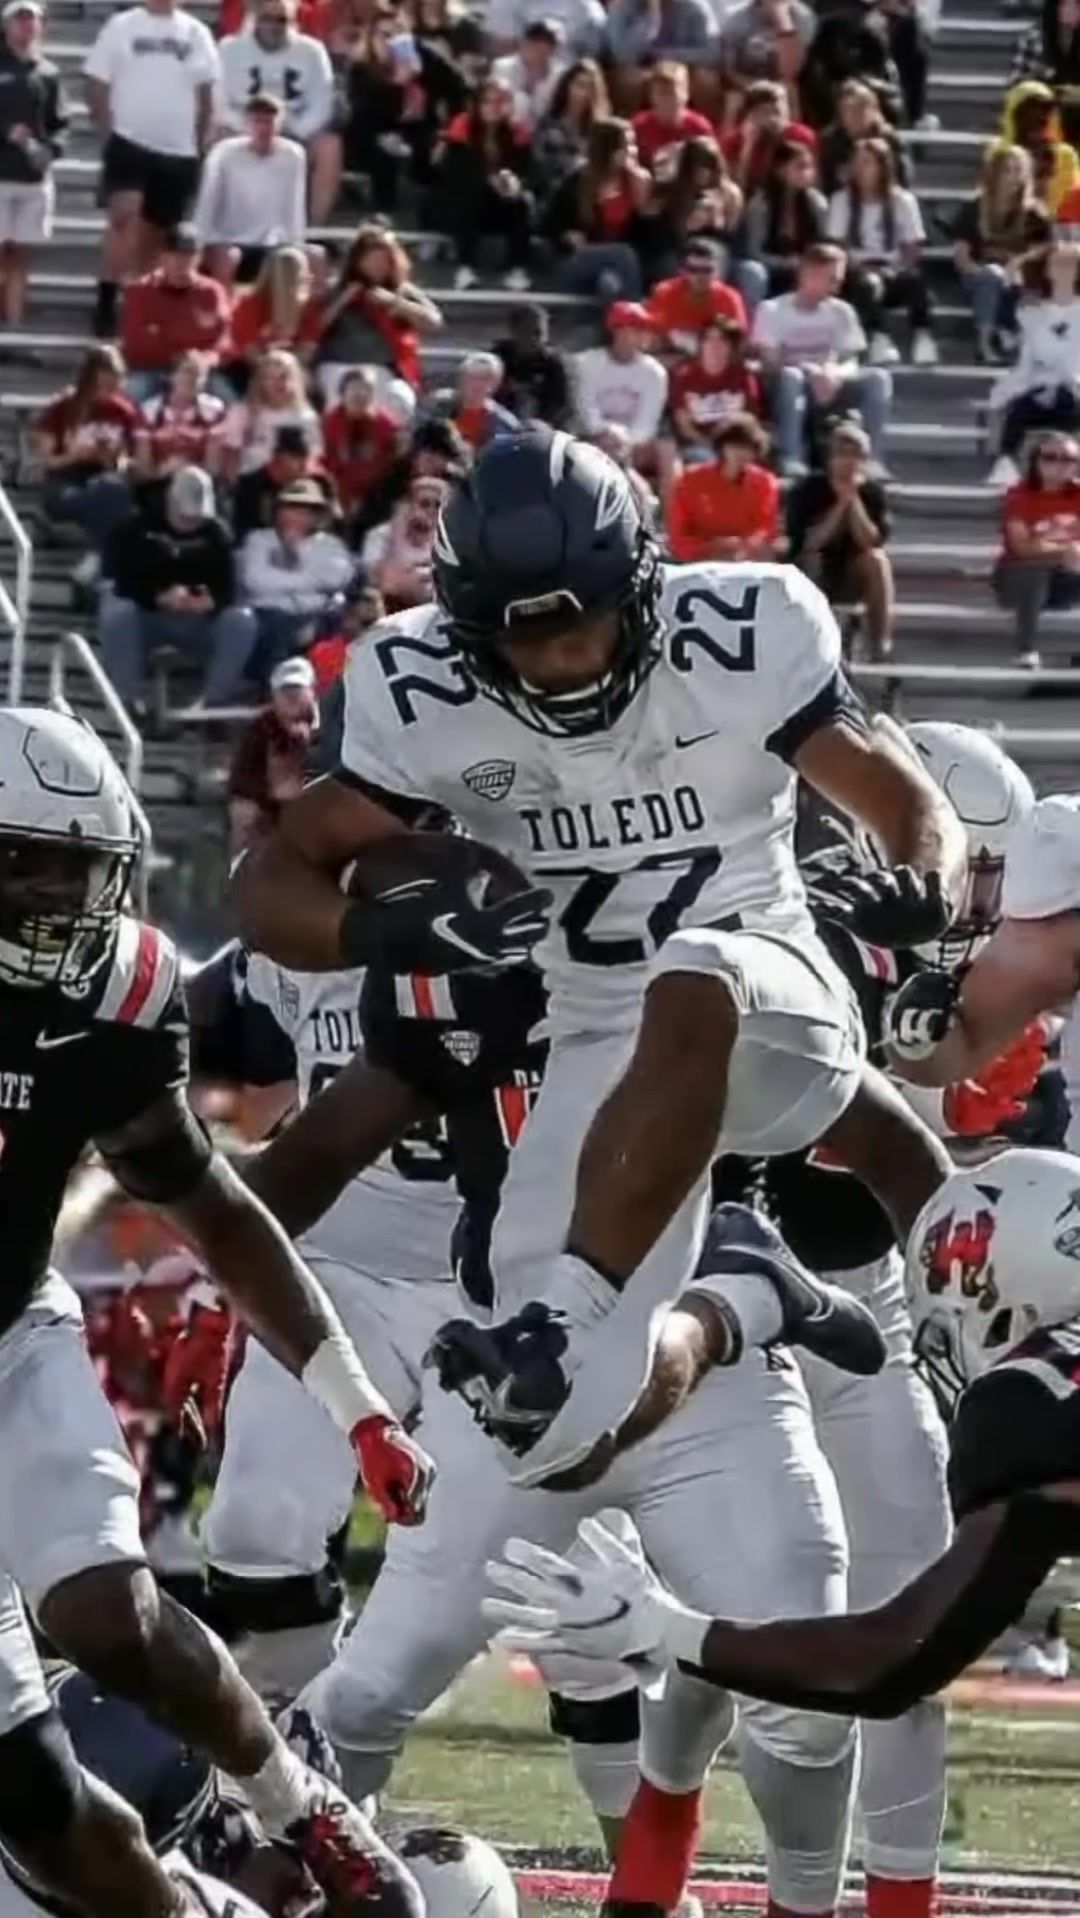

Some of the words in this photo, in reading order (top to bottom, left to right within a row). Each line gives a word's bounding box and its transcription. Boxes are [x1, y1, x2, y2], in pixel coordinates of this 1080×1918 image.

[670, 585, 760, 672] 22
[374, 622, 478, 726] 22
[518, 785, 706, 852] TOLEDO
[0, 1071, 34, 1110] TE
